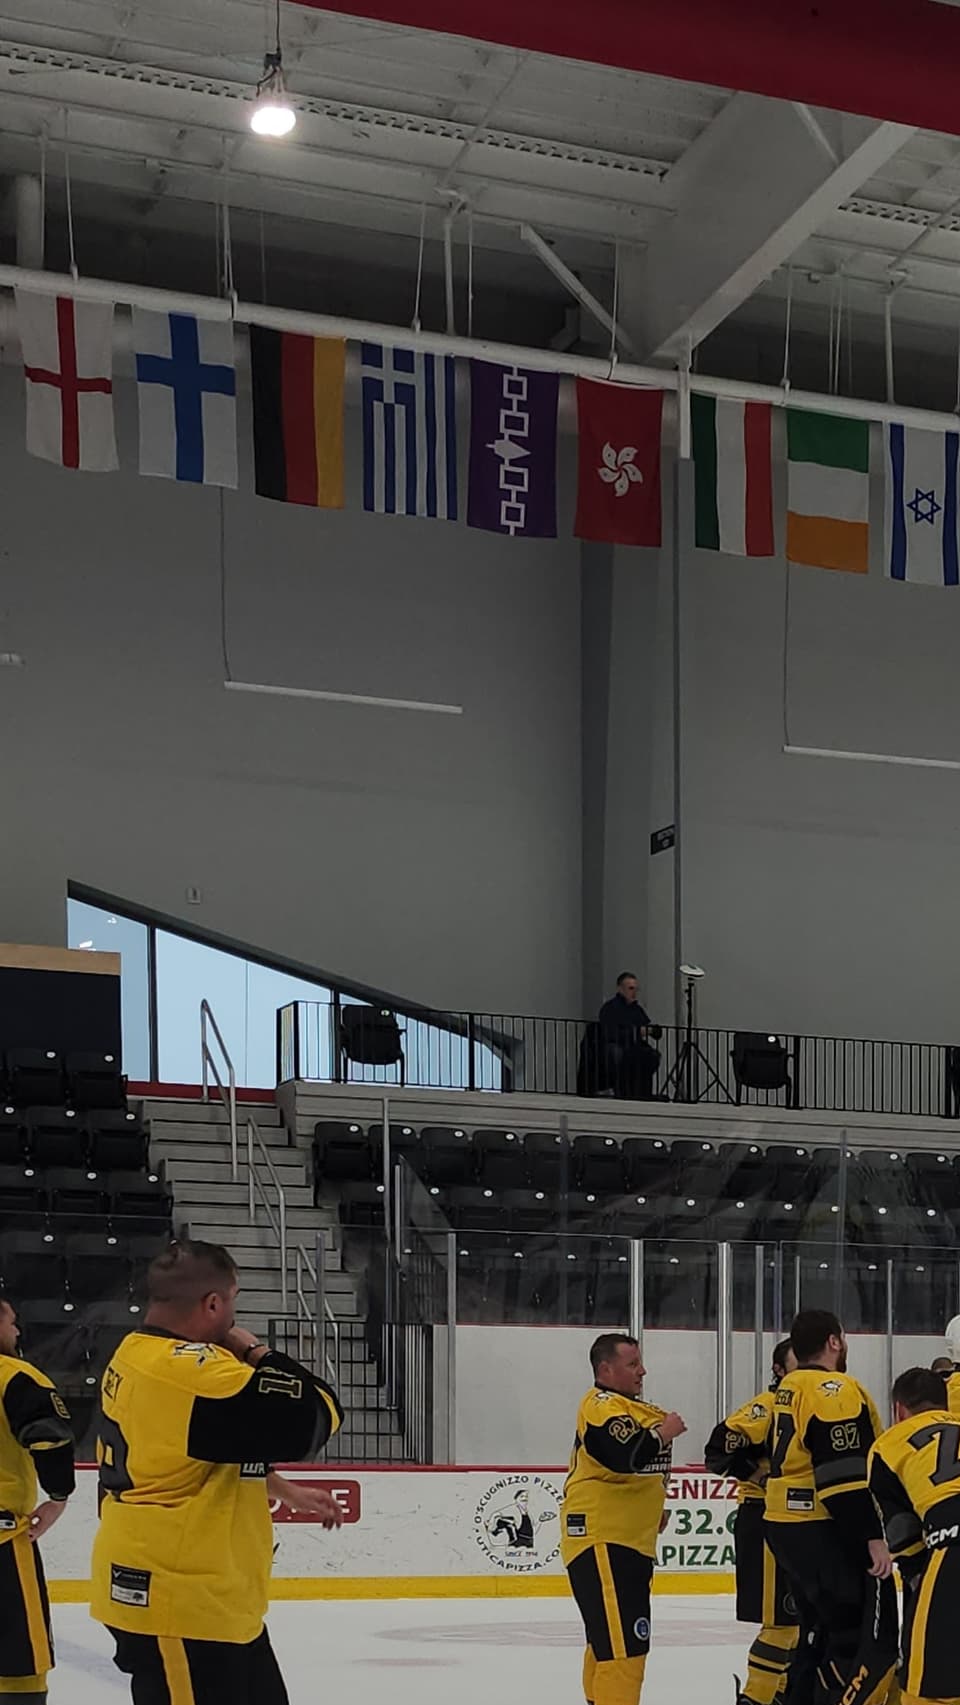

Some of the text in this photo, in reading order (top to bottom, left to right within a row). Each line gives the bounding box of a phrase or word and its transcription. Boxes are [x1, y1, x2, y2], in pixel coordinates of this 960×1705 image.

[829, 1422, 861, 1452] 97
[474, 1475, 565, 1523] O'SCUGNIZZO PIZZE
[666, 1479, 738, 1499] GNIZZ
[476, 1537, 561, 1572] UTICAPIZZA.CO
[658, 1545, 736, 1566] PIZZA
